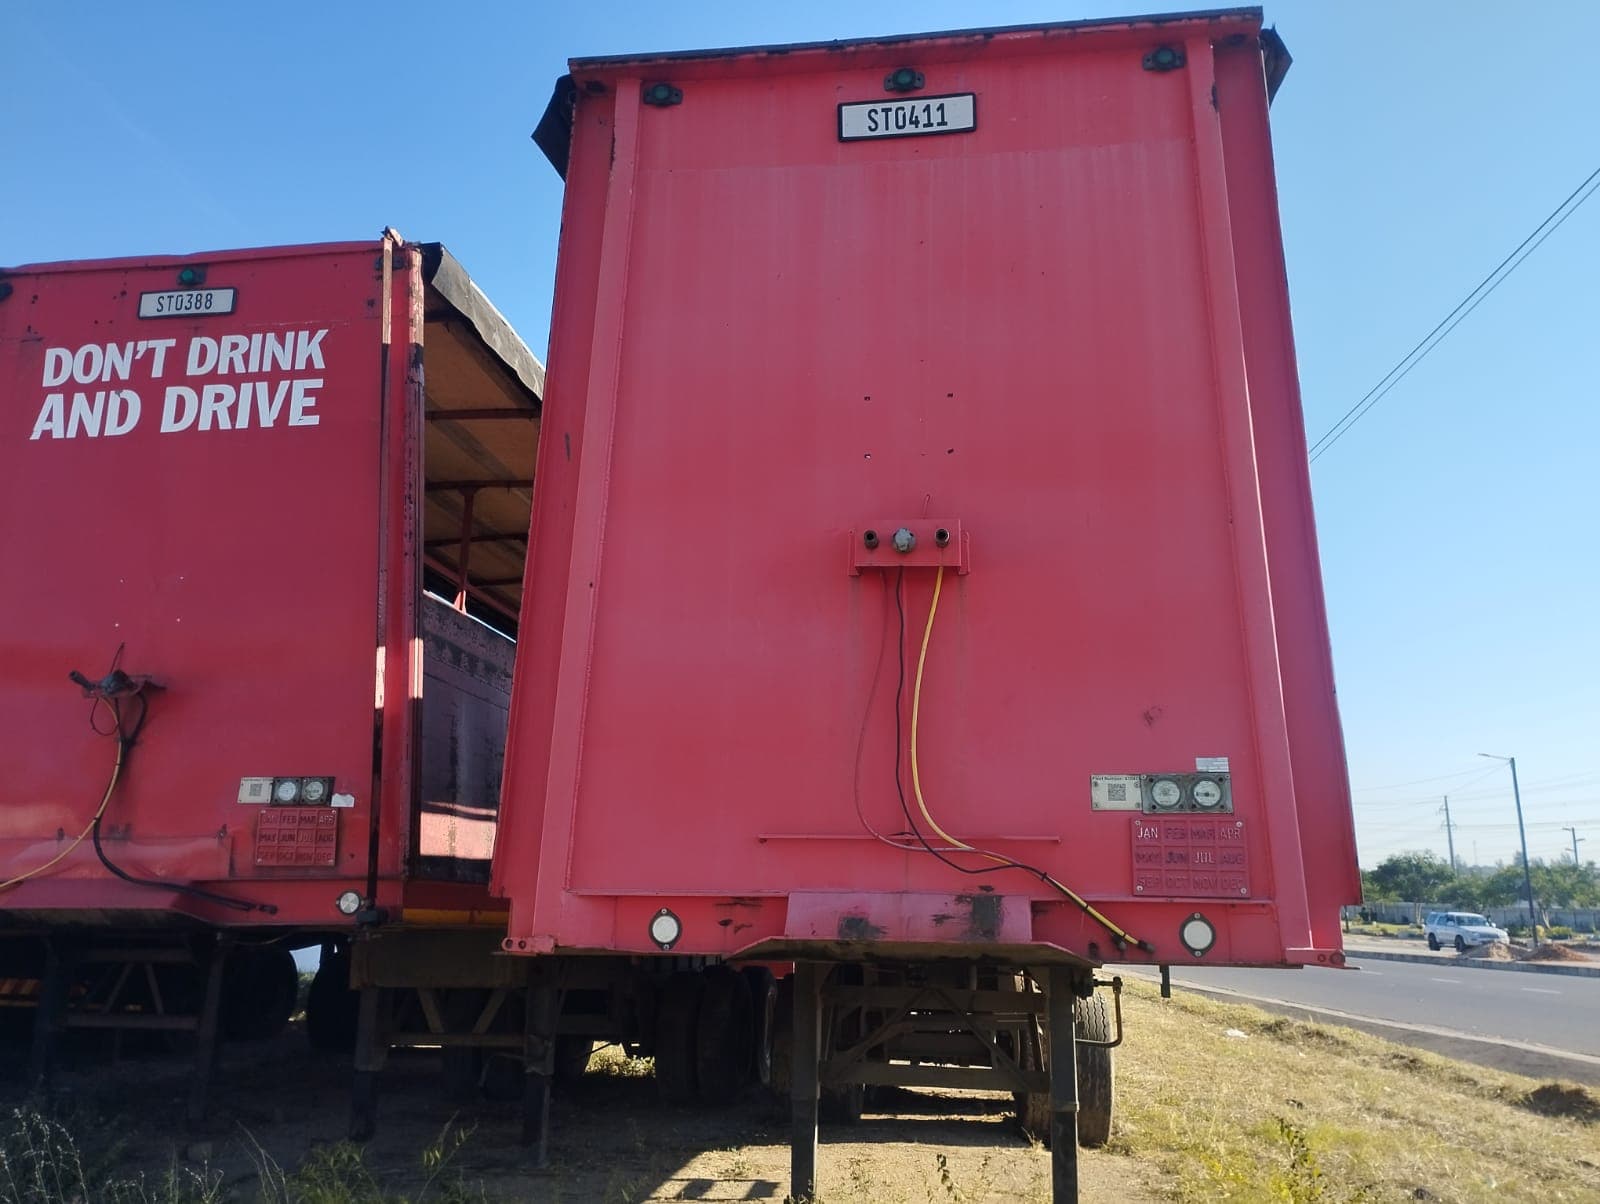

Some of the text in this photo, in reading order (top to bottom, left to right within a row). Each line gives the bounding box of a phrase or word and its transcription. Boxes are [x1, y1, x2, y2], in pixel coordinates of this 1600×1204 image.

[867, 103, 948, 132] ST0411
[156, 292, 214, 313] ST0388
[42, 329, 329, 387] DON'T DRINK
[29, 378, 324, 440] AND DRIVE
[1137, 827, 1158, 839] JAN
[1220, 828, 1241, 840] APR
[1195, 851, 1216, 864] JUL
[1193, 877, 1217, 889] NOV
